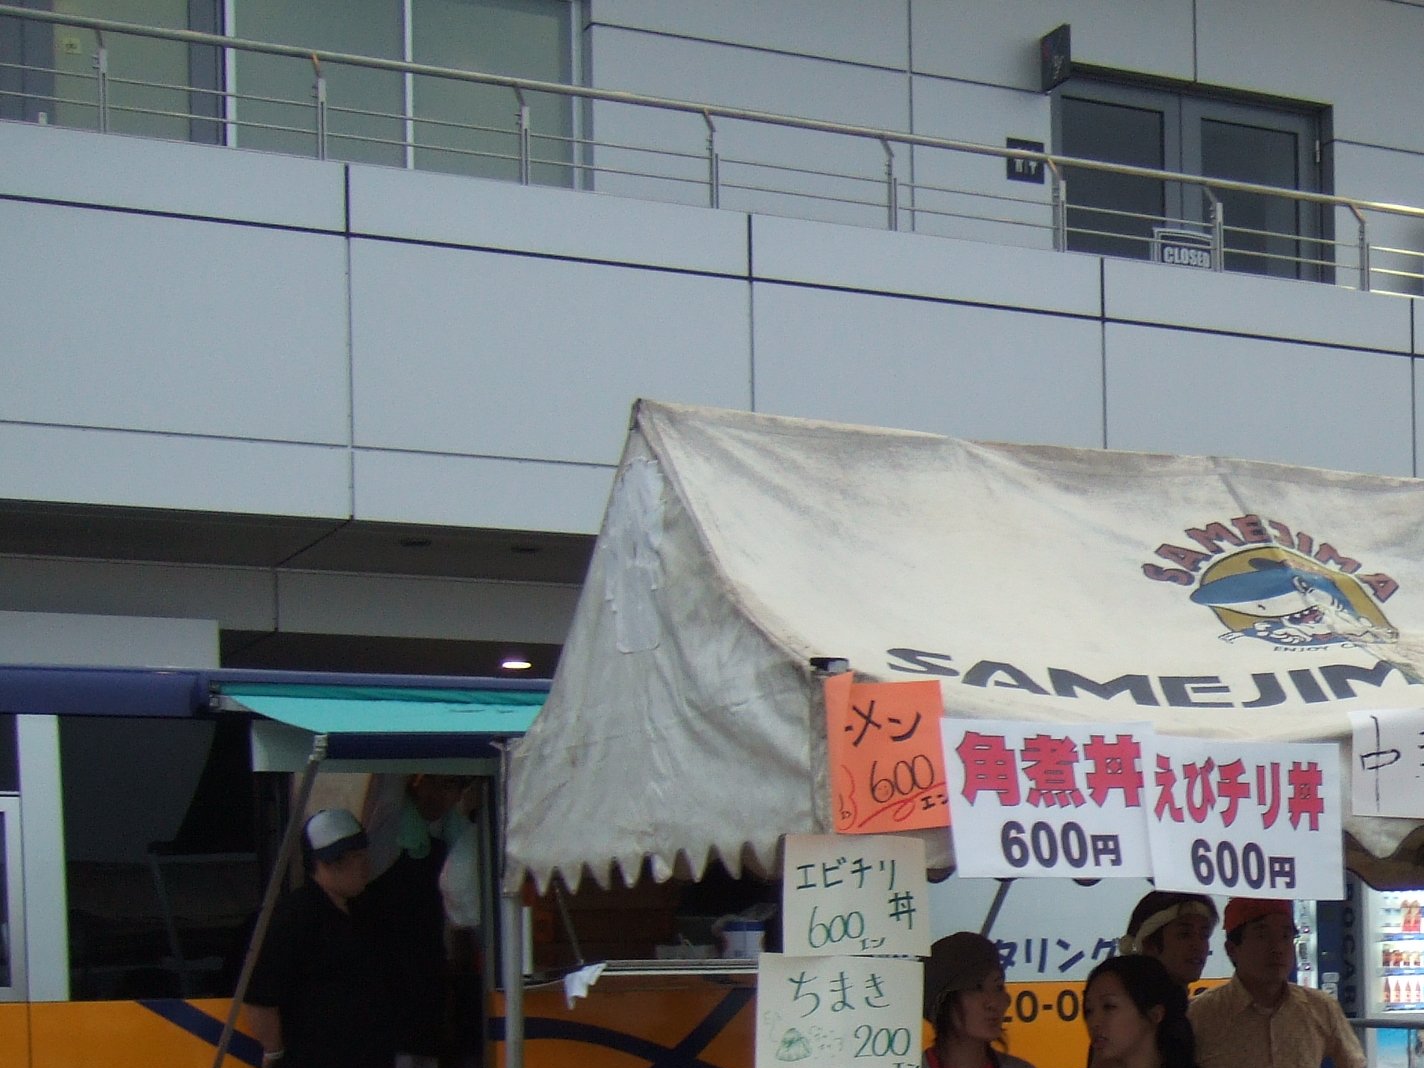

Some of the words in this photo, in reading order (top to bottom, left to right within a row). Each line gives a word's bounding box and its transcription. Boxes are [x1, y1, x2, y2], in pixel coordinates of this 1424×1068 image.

[1163, 246, 1210, 269] CLOSED
[1141, 514, 1400, 603] SAMEJIMA
[870, 754, 934, 803] 600
[957, 731, 1143, 809] 角煮丼
[1154, 752, 1325, 832] えびチリ丼
[1000, 821, 1122, 869] 600円
[1190, 840, 1297, 890] 600円
[796, 857, 897, 891] エビチリ
[808, 906, 864, 948] 600
[888, 891, 916, 930] 丼
[860, 937, 886, 951] エン
[788, 971, 890, 1018] ちまき
[853, 1024, 911, 1058] 200
